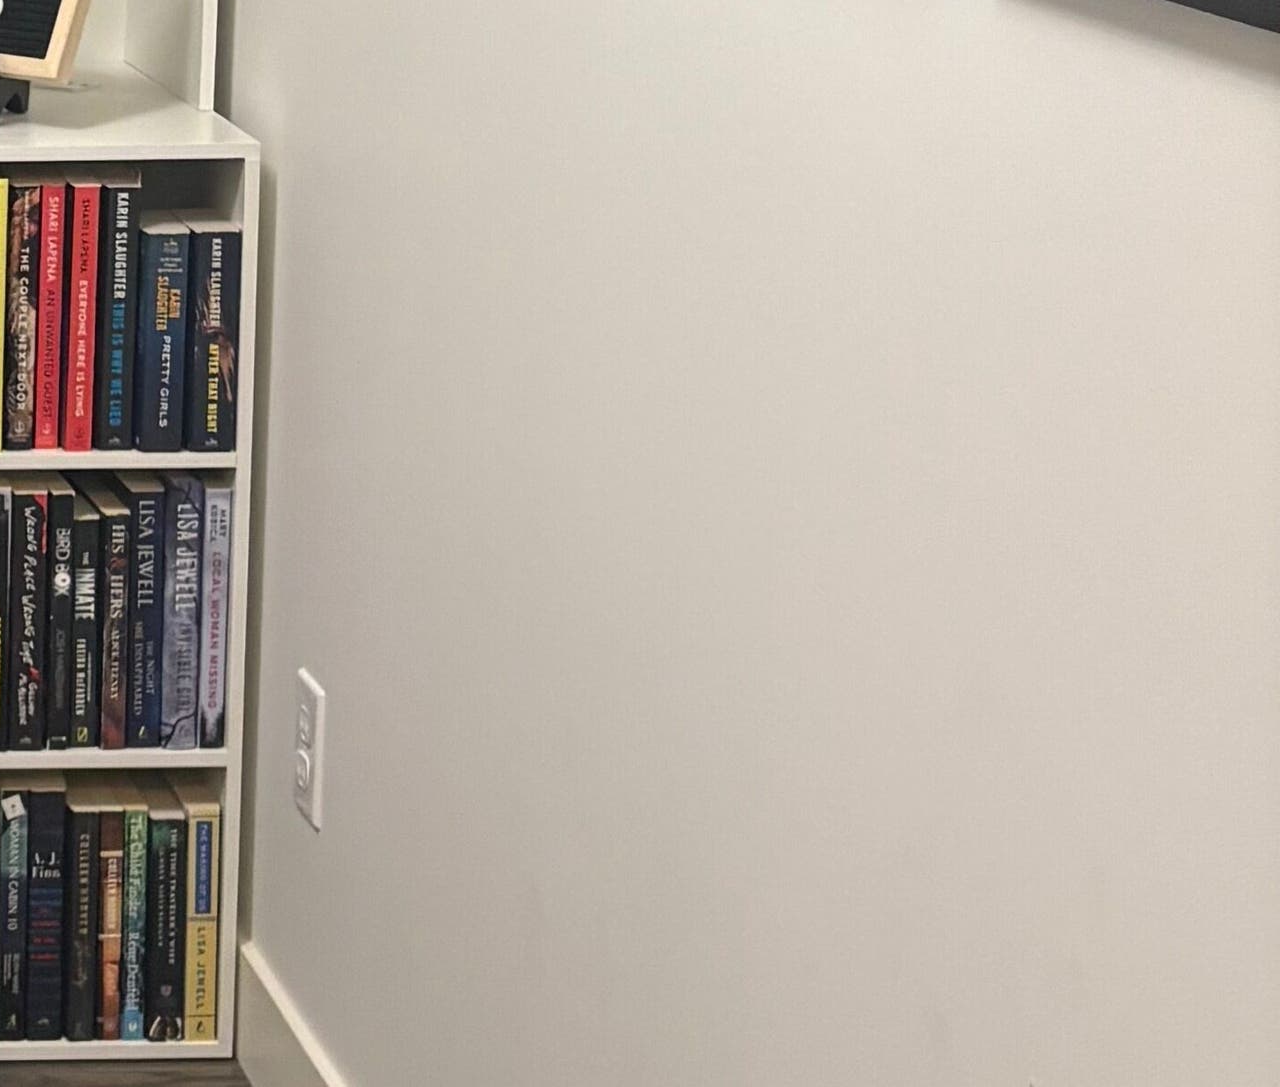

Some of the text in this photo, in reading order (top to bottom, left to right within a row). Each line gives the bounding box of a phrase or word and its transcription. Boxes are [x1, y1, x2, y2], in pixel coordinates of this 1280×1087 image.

[20, 247, 30, 273] THE
[46, 196, 60, 283] SHARI LAPENA
[114, 192, 130, 300] KARIN SLAUGHTER
[19, 276, 30, 328] COUPLE
[46, 289, 56, 307] AN
[156, 275, 169, 331] SLAUGHTER
[209, 238, 222, 327] KARIN SLAUGHTER
[113, 303, 125, 329] THIS
[18, 334, 28, 367] NEXT
[74, 280, 89, 417] EVERYONE HERE IS LYING
[112, 333, 123, 345] IS
[208, 343, 219, 374] AFTER
[16, 372, 26, 411] DOOR
[159, 335, 171, 428] PRETTY GIRLS
[24, 506, 38, 553] WRONG
[112, 525, 125, 553] HIS
[24, 554, 38, 592] PLACE
[54, 528, 71, 597] BIRD BOX
[137, 500, 155, 609] LISA JEWELL
[175, 504, 199, 612] LISA JEWELL
[22, 594, 37, 637] WRONG
[74, 568, 95, 620] INMATE
[110, 575, 124, 619] HERS
[208, 551, 222, 709] LOCAL WOMAN MISSING
[49, 851, 60, 865] J.
[80, 834, 89, 884] COLLEEN
[8, 880, 19, 914] CABIN
[7, 918, 18, 930] 10
[168, 939, 176, 965] WIFE
[196, 926, 206, 1009] LISA JEWELL
